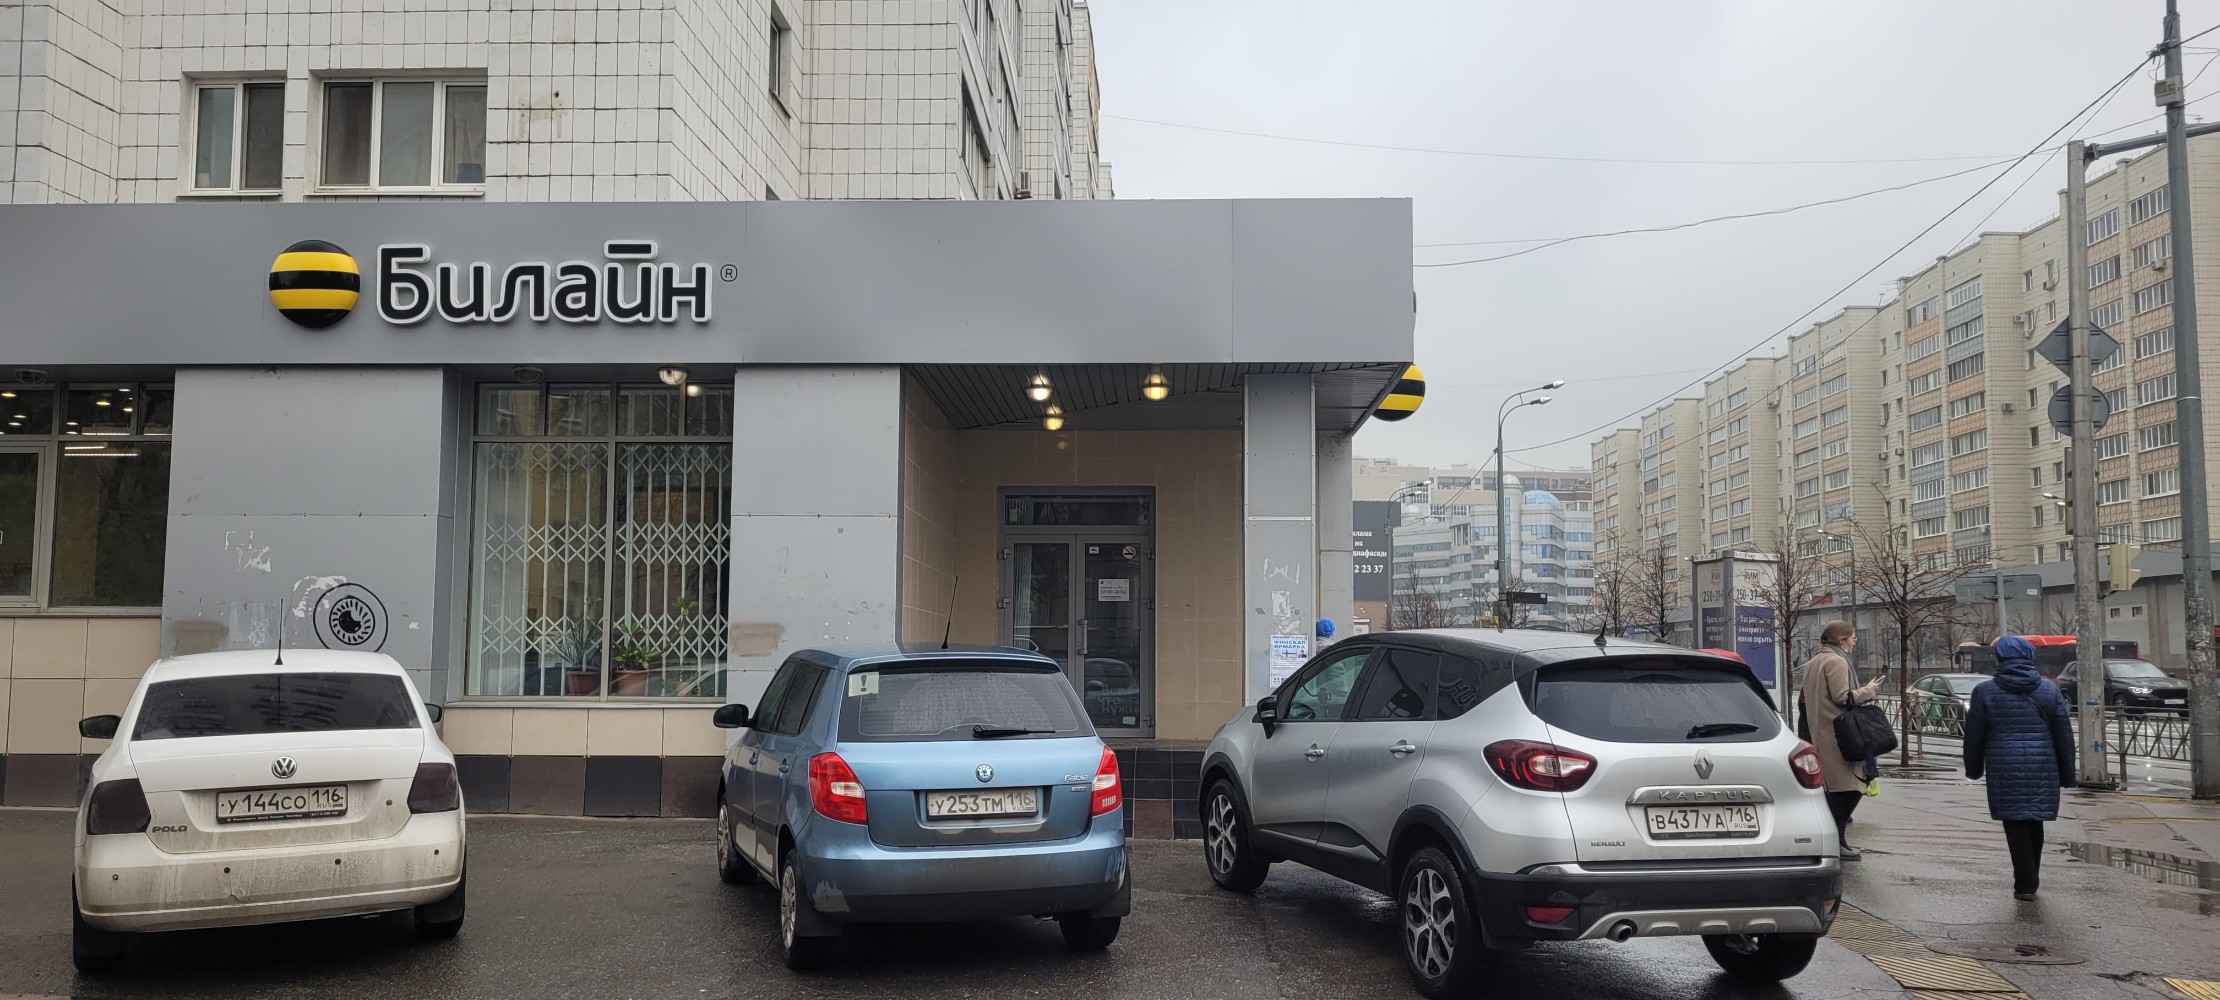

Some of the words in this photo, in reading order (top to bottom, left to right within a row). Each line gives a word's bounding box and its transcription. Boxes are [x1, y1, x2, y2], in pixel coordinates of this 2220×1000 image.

[378, 240, 711, 323] Билайн
[1361, 565, 1372, 573] 23
[1373, 565, 1384, 573] 37
[1064, 774, 1089, 782] Fabia
[311, 788, 341, 804] 116
[1006, 791, 1031, 807] 116
[1658, 790, 1752, 800] KAPTUR
[1726, 807, 1752, 822] 716
[152, 825, 188, 833] POLO
